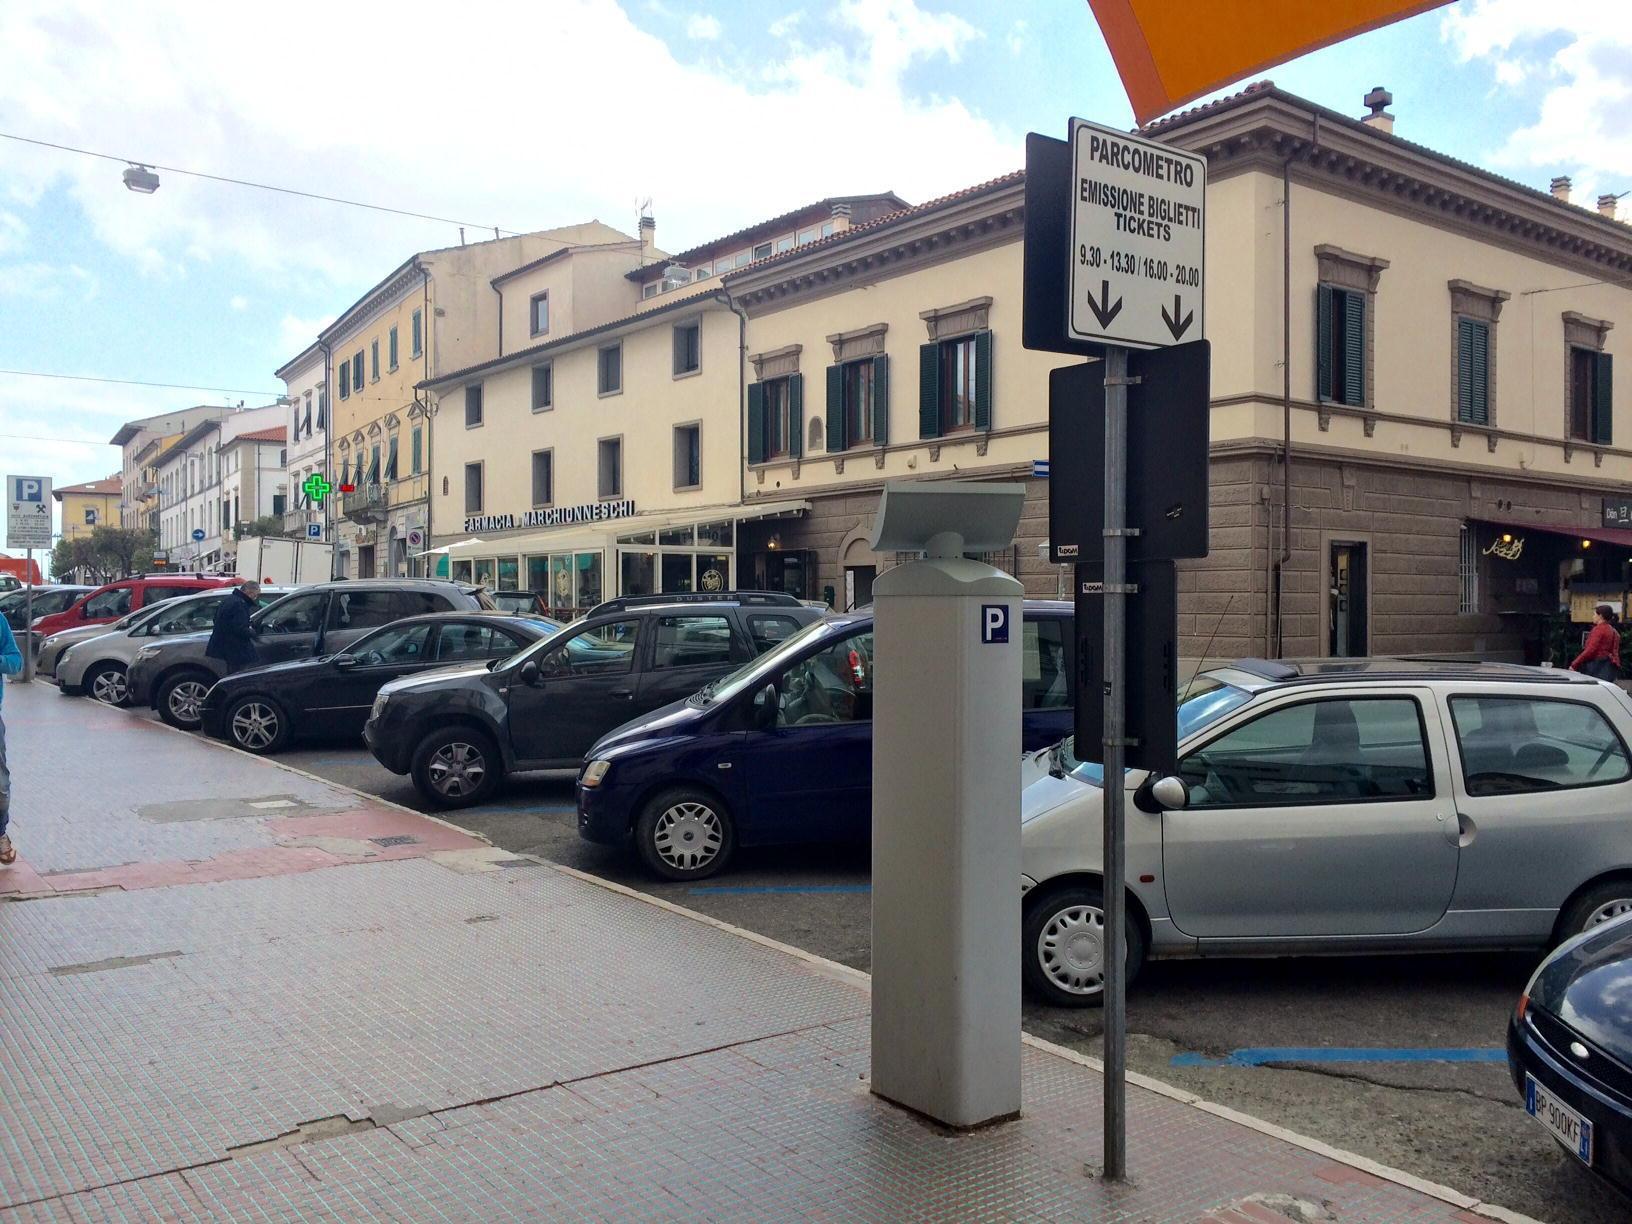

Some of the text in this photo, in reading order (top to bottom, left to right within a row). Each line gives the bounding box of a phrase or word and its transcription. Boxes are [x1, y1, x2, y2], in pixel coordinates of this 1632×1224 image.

[1090, 135, 1194, 188] PARCOMETRO
[1080, 178, 1200, 229] EMISSIONE BIGLIETTI
[1114, 212, 1171, 242] TICKETS
[1080, 243, 1101, 268] 9.30
[1110, 249, 1136, 275] 13.30
[1138, 255, 1142, 276] /
[1143, 258, 1168, 282] 16.00
[1175, 263, 1199, 288] 20.00
[22, 480, 38, 500] P
[311, 525, 319, 535] P
[464, 500, 635, 533] FARMACIA MARCHIONNESCHI
[986, 607, 1004, 641] P
[1535, 1090, 1579, 1142] BP 900KF
